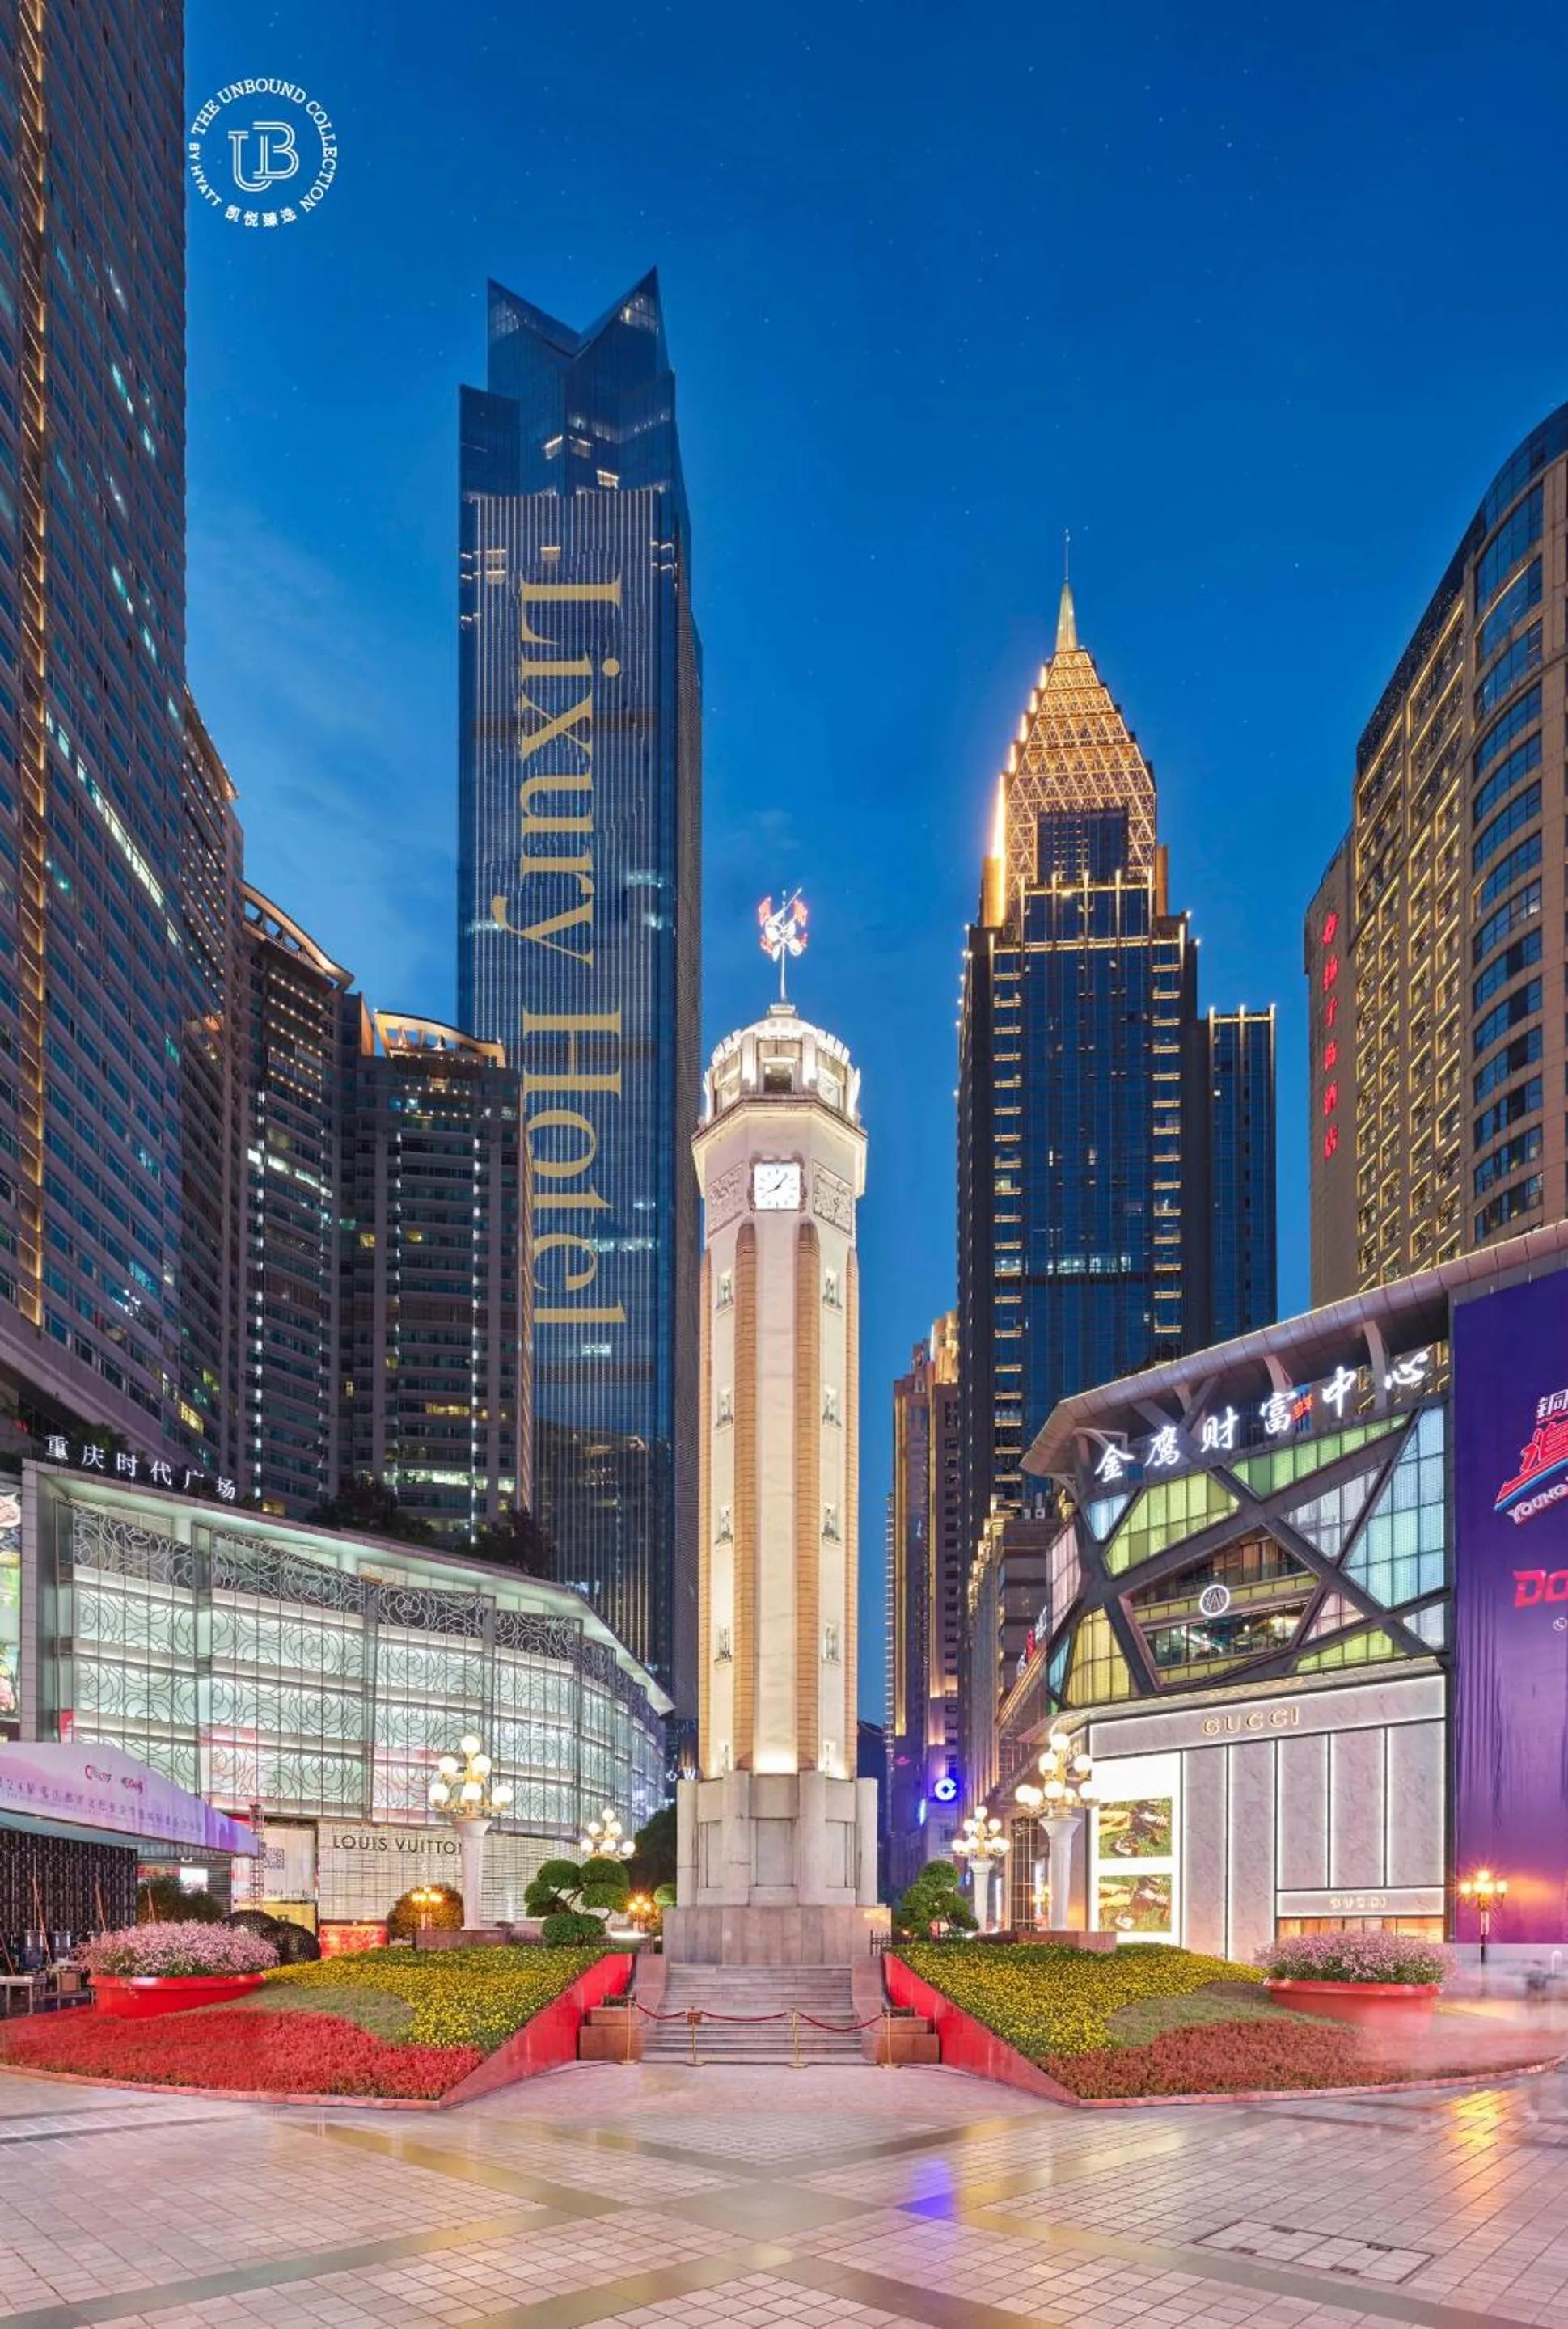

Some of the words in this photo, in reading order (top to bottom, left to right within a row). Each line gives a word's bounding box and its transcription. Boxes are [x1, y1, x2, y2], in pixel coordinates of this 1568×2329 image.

[492, 576, 622, 966] Lixury
[522, 1006, 628, 1325] Hotel
[1094, 1346, 1434, 1483] 金鹰财富中心
[44, 1435, 236, 1499] 重庆时代广场
[1203, 1706, 1299, 1736] GUCCI
[332, 1834, 387, 1851] LOUIS
